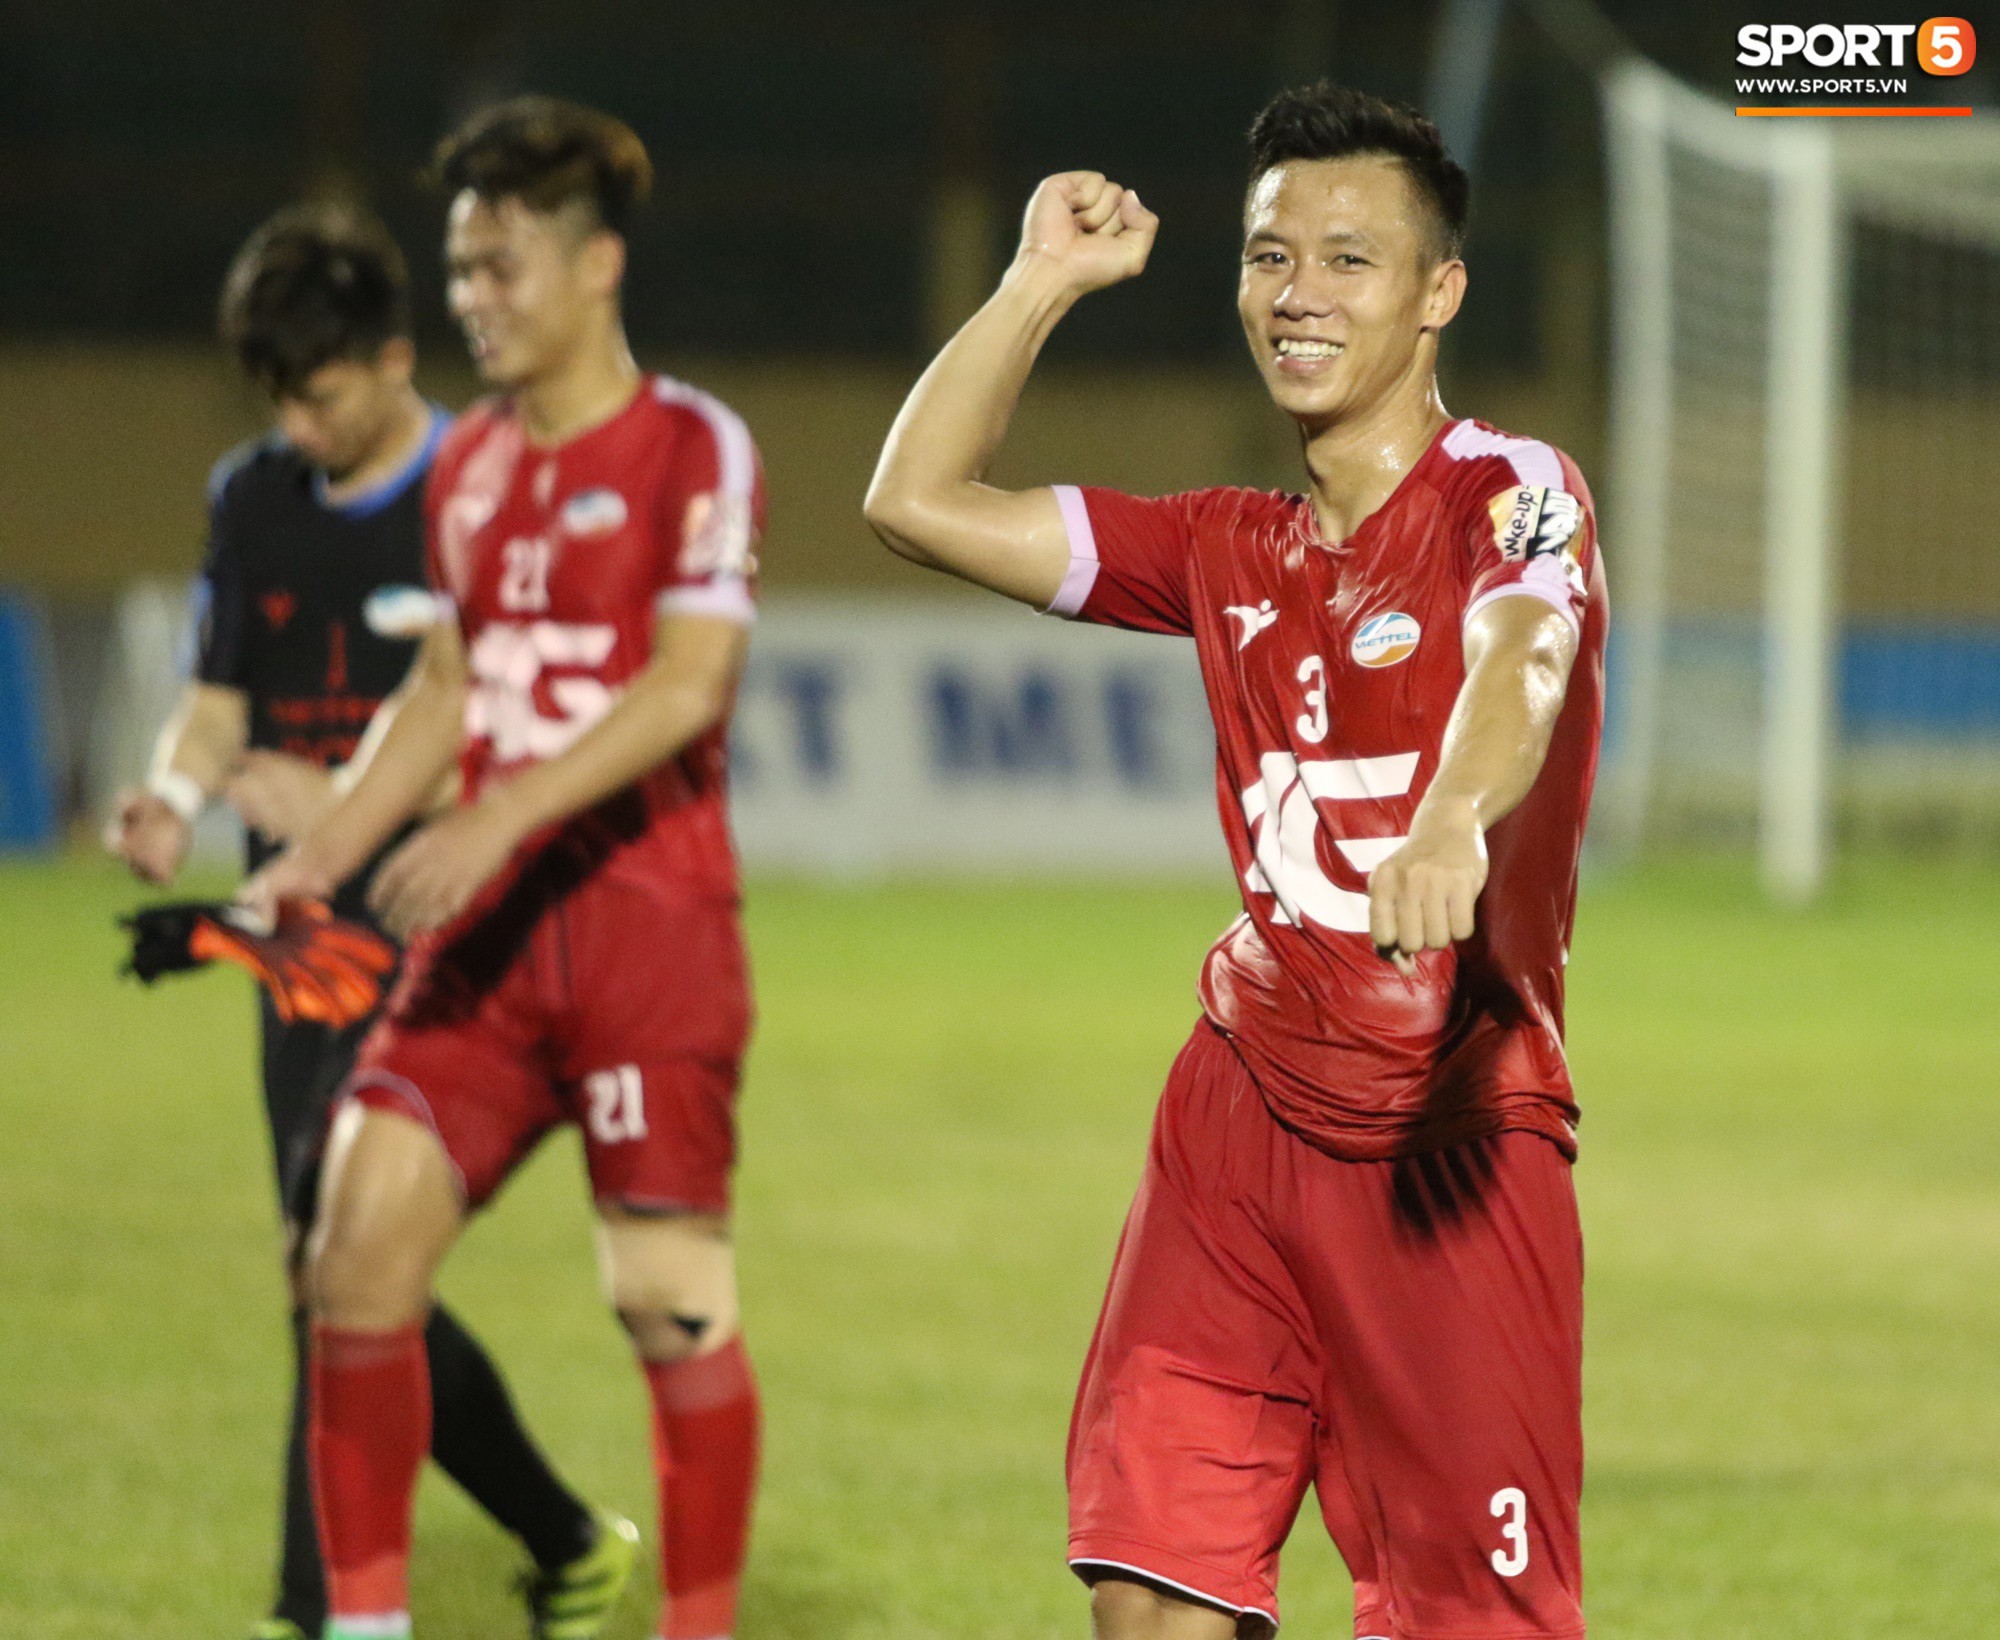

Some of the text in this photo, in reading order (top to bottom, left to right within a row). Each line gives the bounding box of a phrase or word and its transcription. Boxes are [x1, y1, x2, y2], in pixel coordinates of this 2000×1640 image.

[500, 536, 549, 612] 21
[1296, 654, 1329, 744] 3
[584, 1062, 648, 1144] 21
[1490, 1487, 1529, 1577] 3
